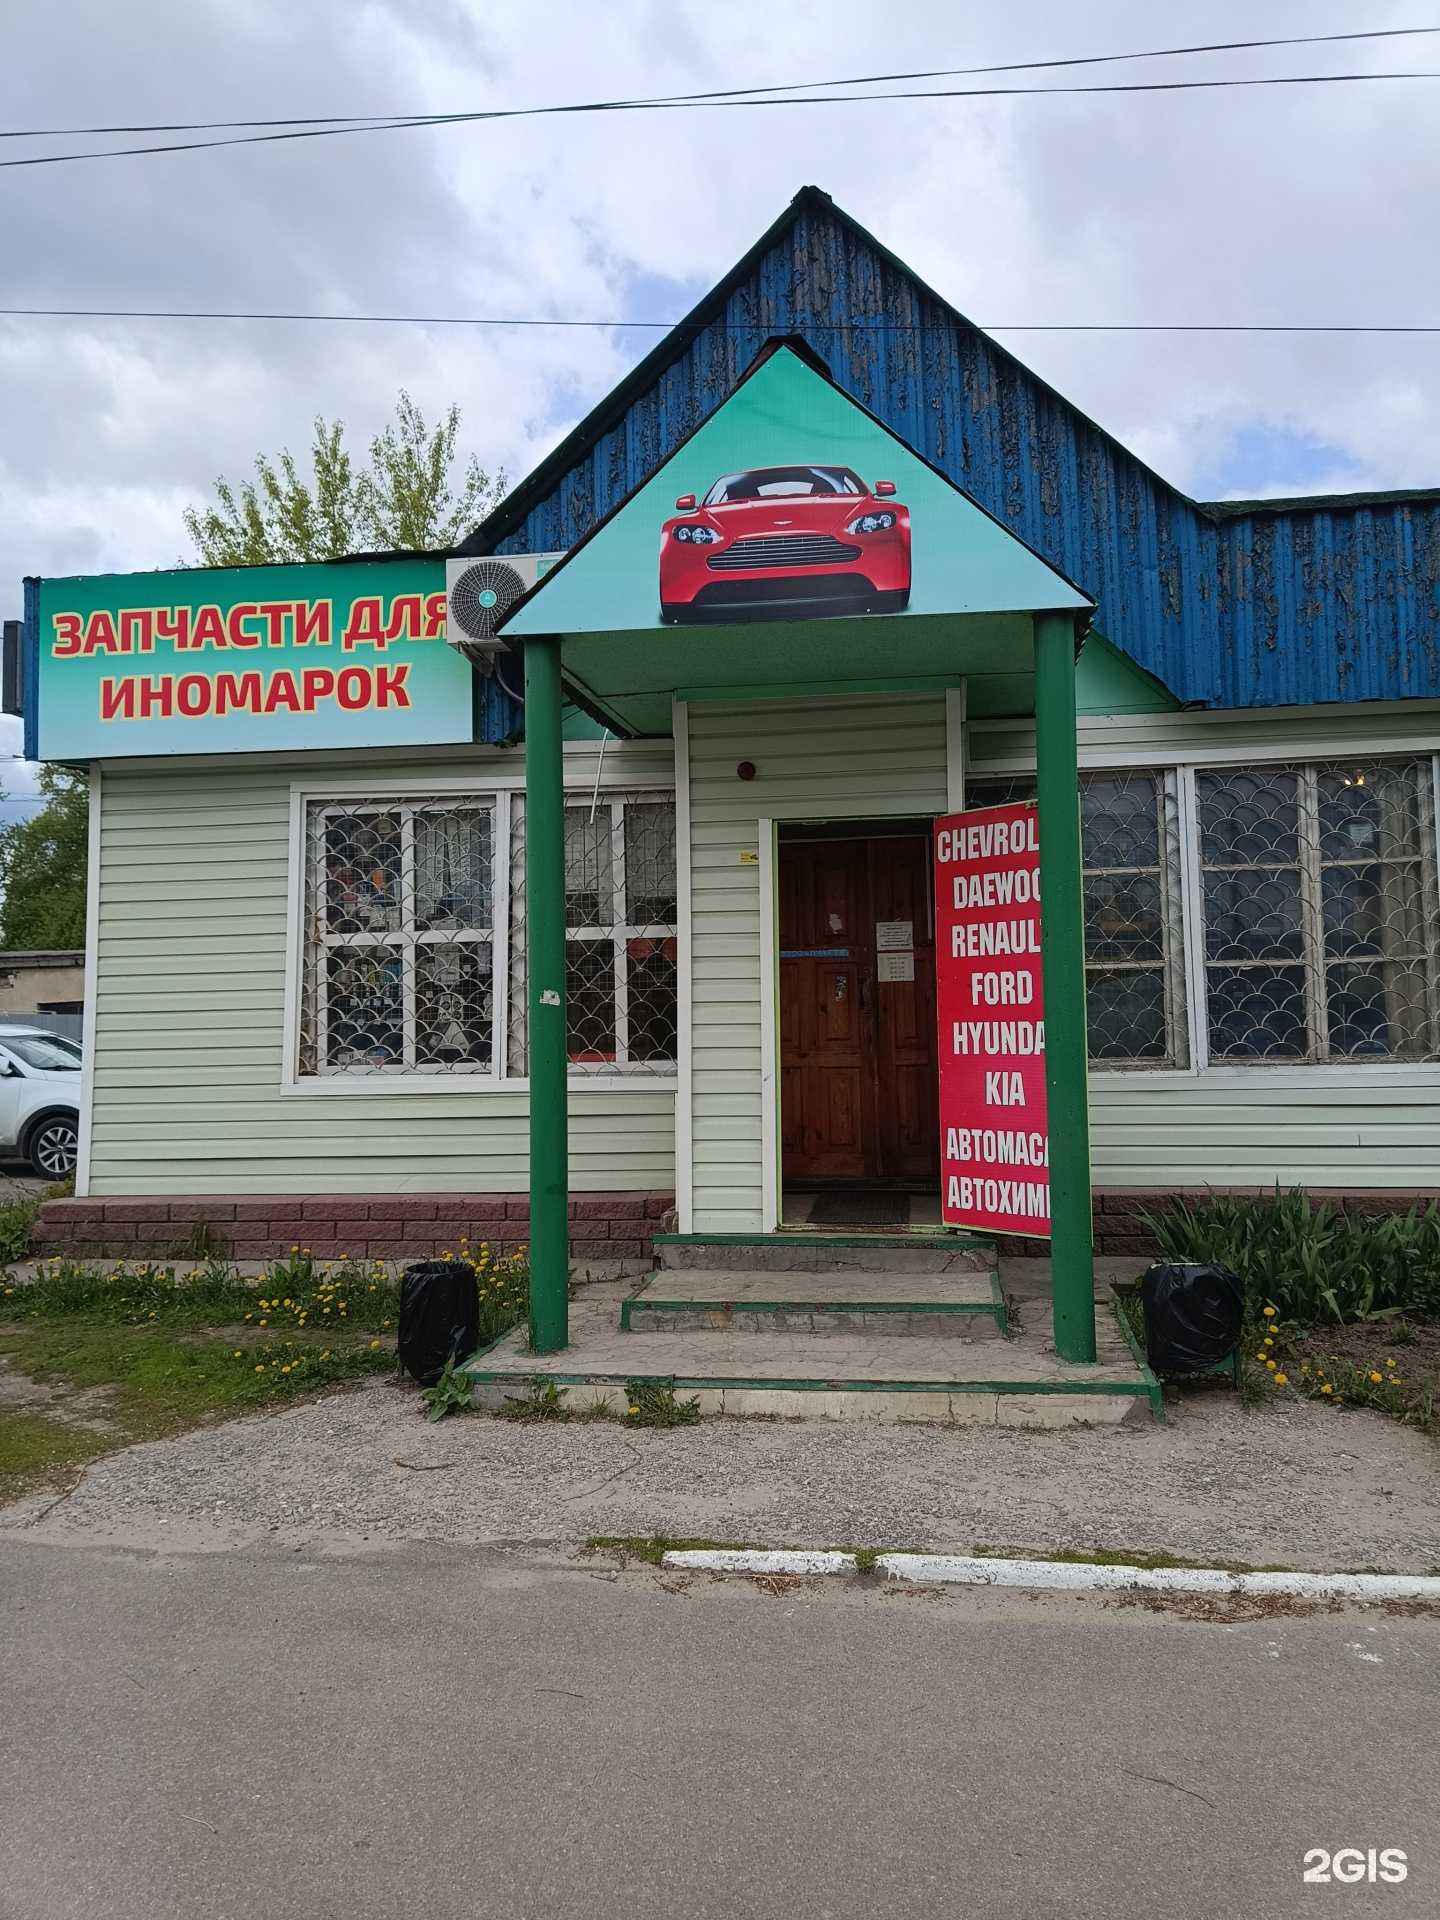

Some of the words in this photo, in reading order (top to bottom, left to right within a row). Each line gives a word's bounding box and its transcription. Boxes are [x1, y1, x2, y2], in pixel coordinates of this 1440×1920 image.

[52, 598, 332, 658] ЗАПЧАСТИ
[341, 592, 447, 652] ДЛЯ
[100, 663, 412, 722] ИНОМАРОК
[952, 918, 1042, 957] RENAUL
[971, 970, 1033, 1006] FORD
[953, 1021, 1046, 1055] HYUNDA
[985, 1071, 1026, 1106] KIA
[947, 1176, 1051, 1218] АВТОХИМ
